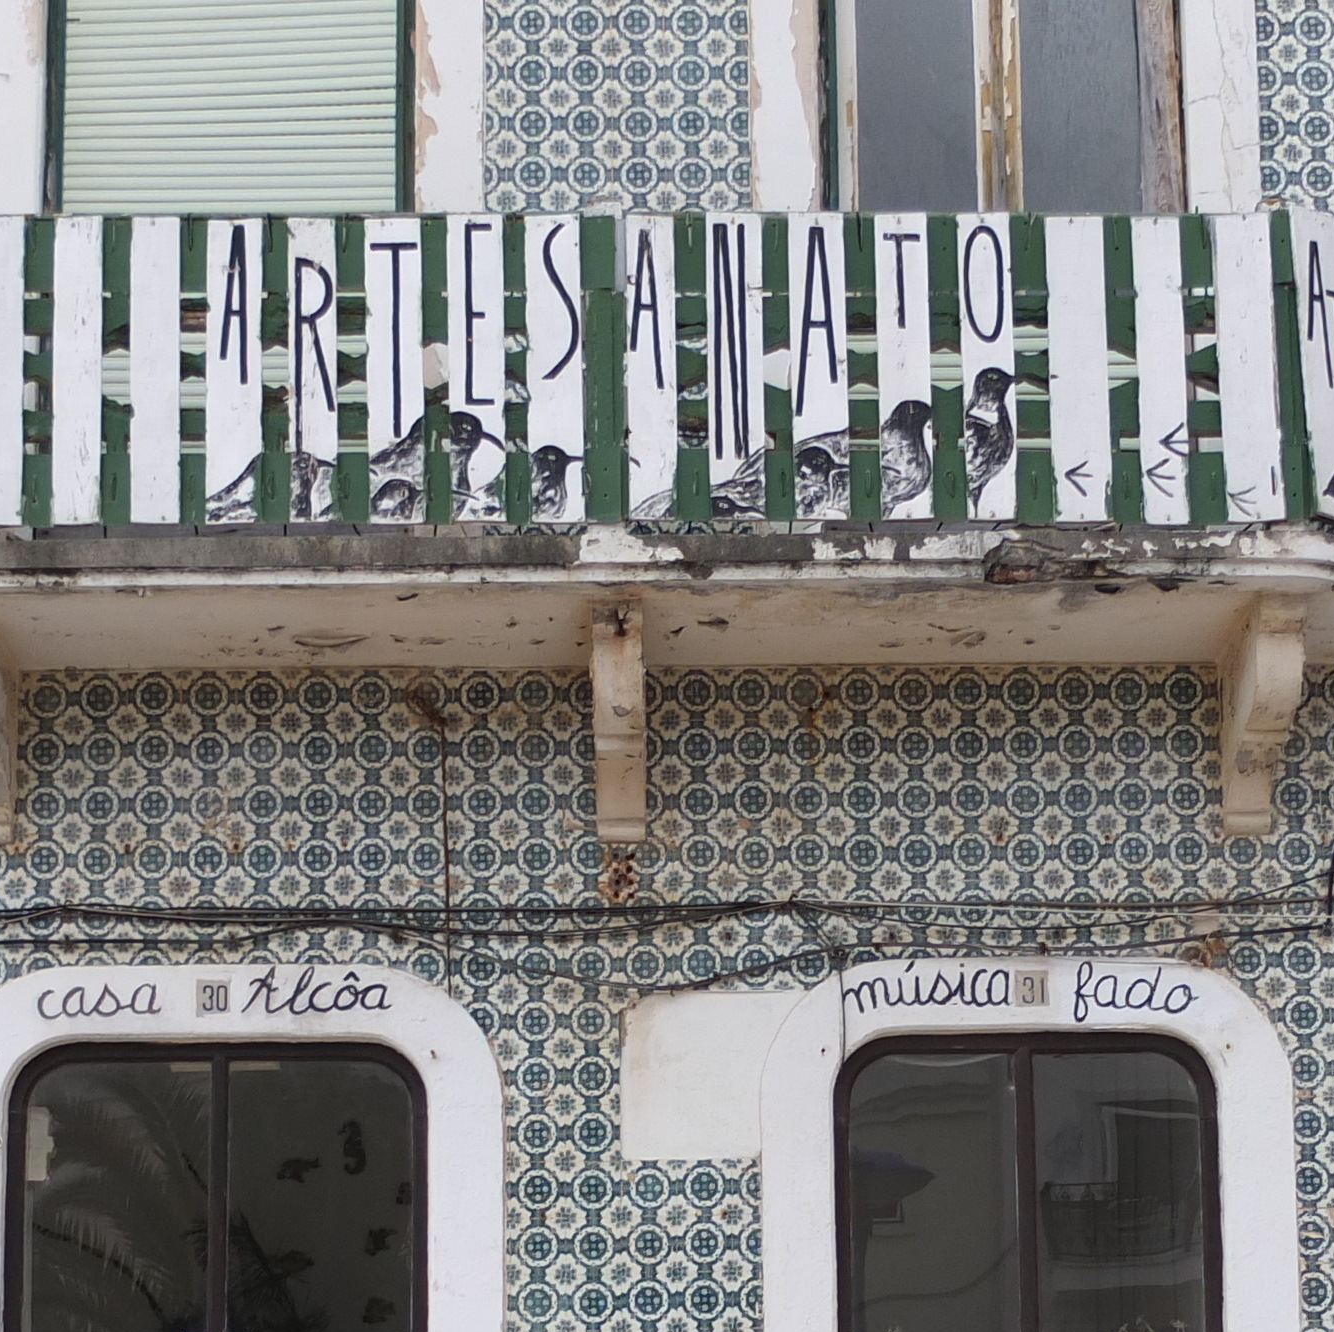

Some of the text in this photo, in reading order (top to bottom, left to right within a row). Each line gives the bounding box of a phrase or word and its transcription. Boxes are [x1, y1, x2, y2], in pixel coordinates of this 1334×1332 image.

[219, 223, 1004, 460] ARTESANATO
[37, 966, 393, 1019] casa 30 Alcôa
[843, 961, 1013, 1014] música
[1072, 961, 1199, 1022] fado
